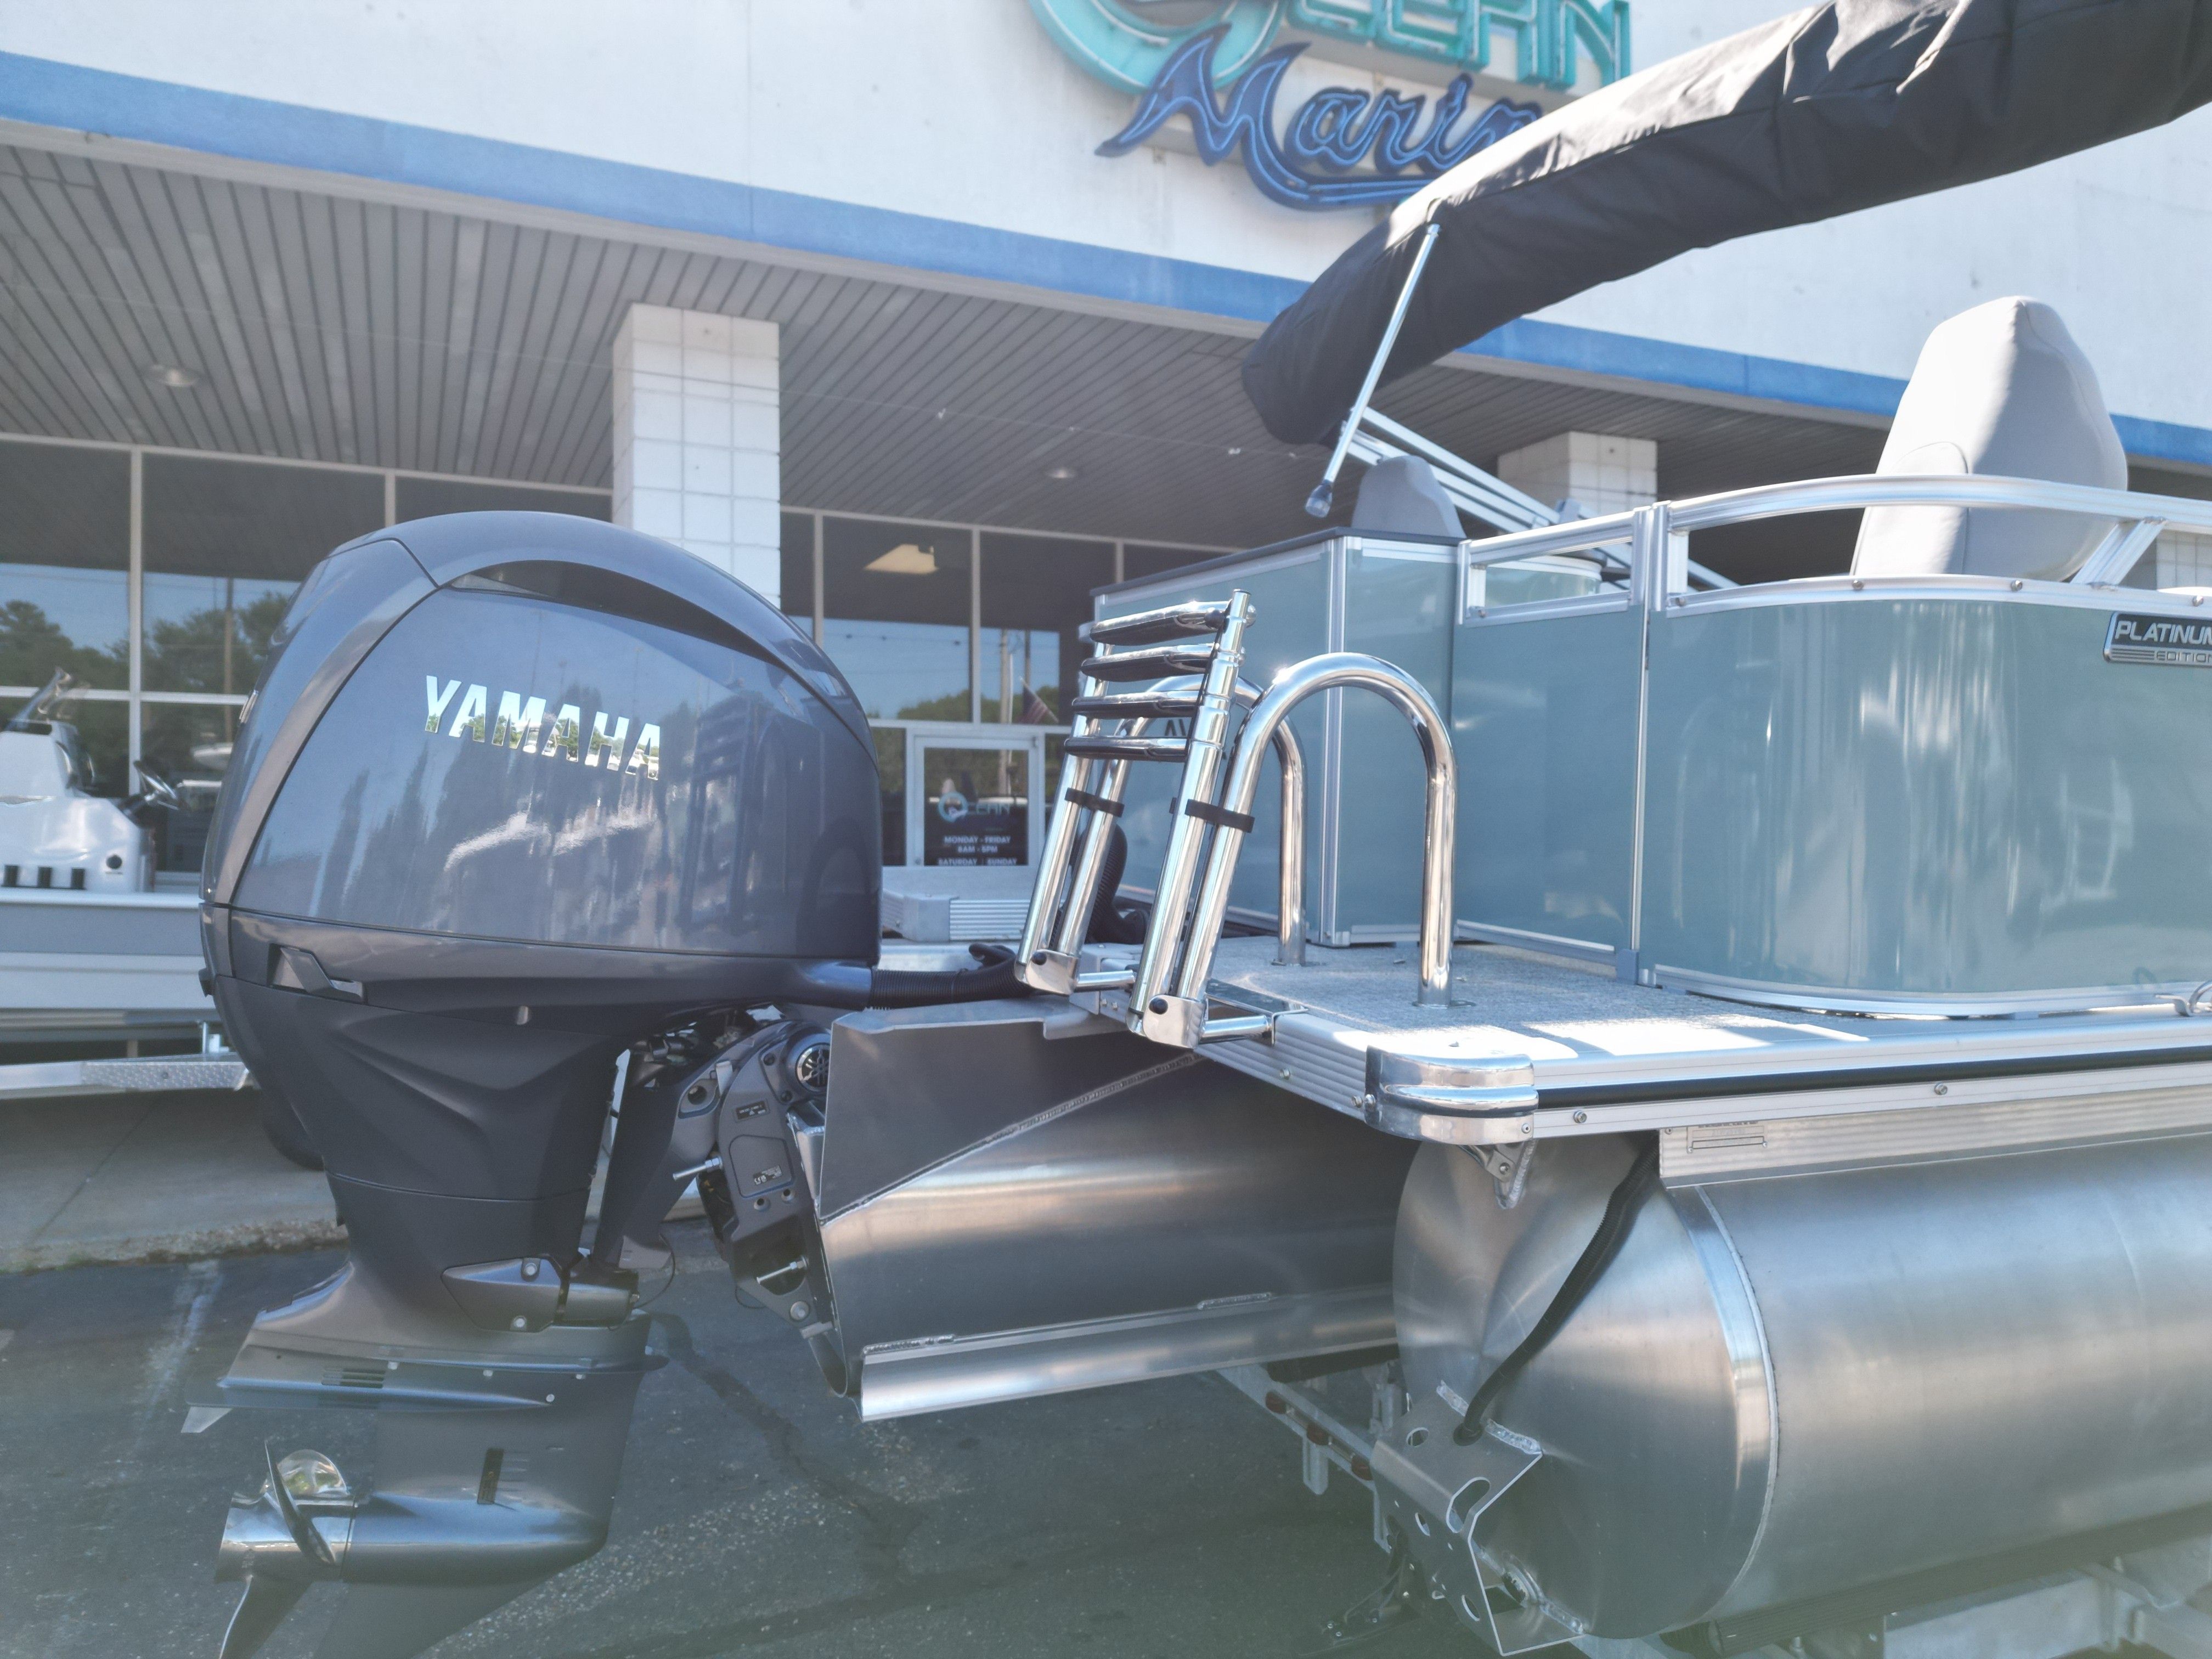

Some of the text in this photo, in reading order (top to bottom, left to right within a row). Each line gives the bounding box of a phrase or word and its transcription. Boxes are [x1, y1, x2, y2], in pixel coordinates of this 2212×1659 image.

[425, 675, 661, 781] YAMAHA
[944, 836, 978, 844] MONDAY
[985, 836, 1011, 844] FRIDAY
[938, 857, 977, 866] SATURDAY
[987, 857, 1017, 866] SUNDAY
